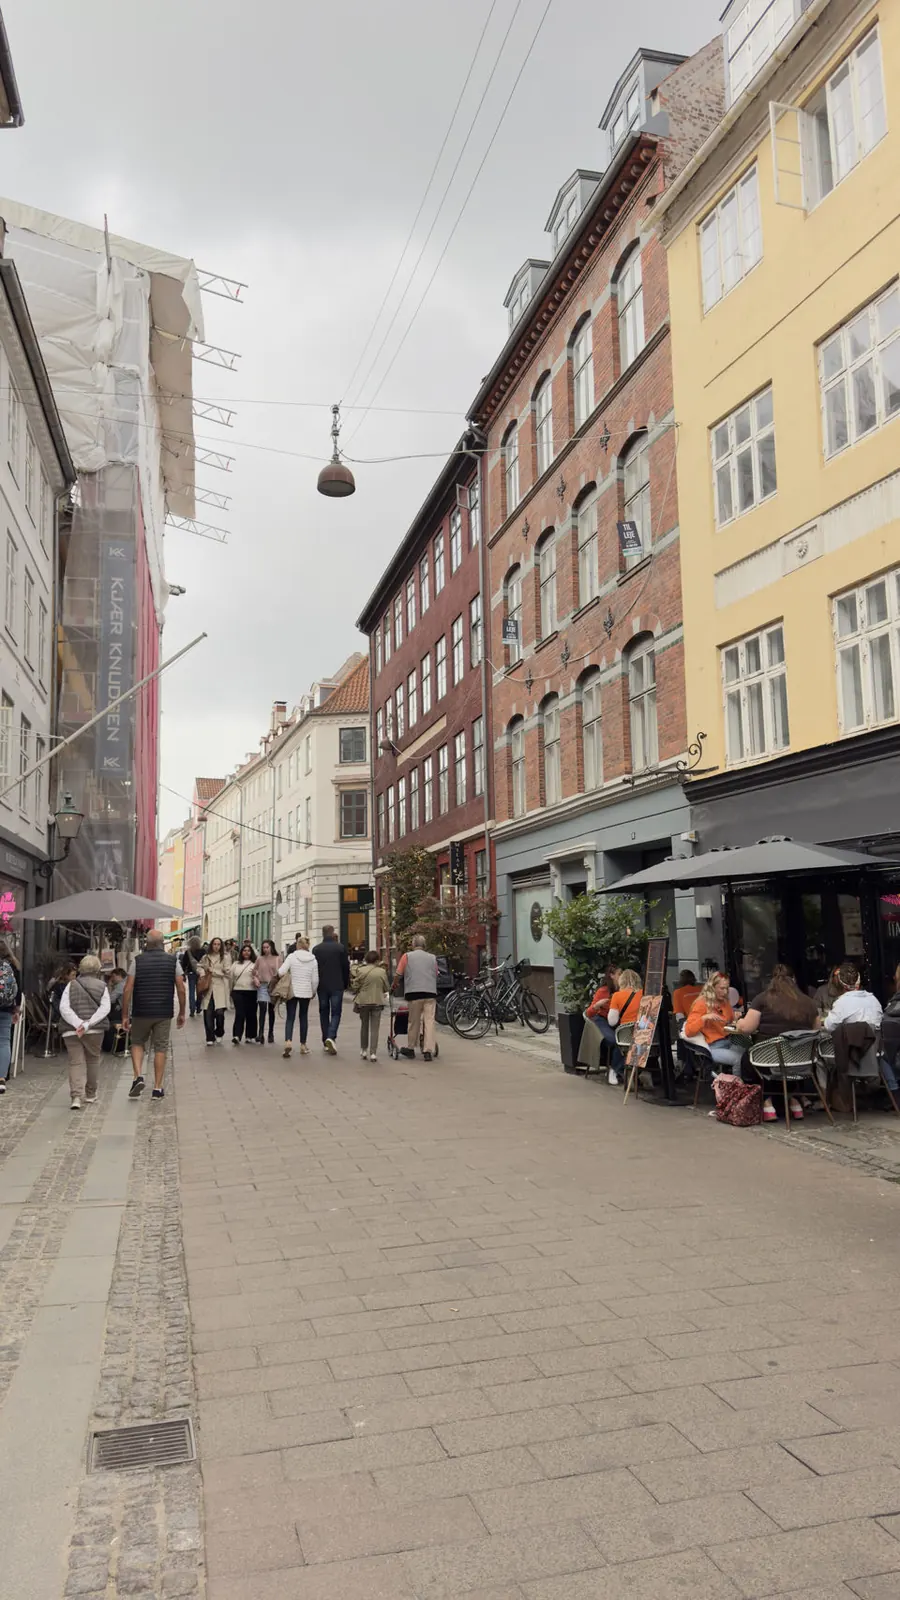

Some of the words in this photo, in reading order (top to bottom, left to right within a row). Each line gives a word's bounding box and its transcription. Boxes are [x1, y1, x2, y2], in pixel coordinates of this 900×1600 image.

[622, 523, 632, 531] TIL
[623, 531, 636, 540] LEJE
[110, 576, 124, 636] KJÆR
